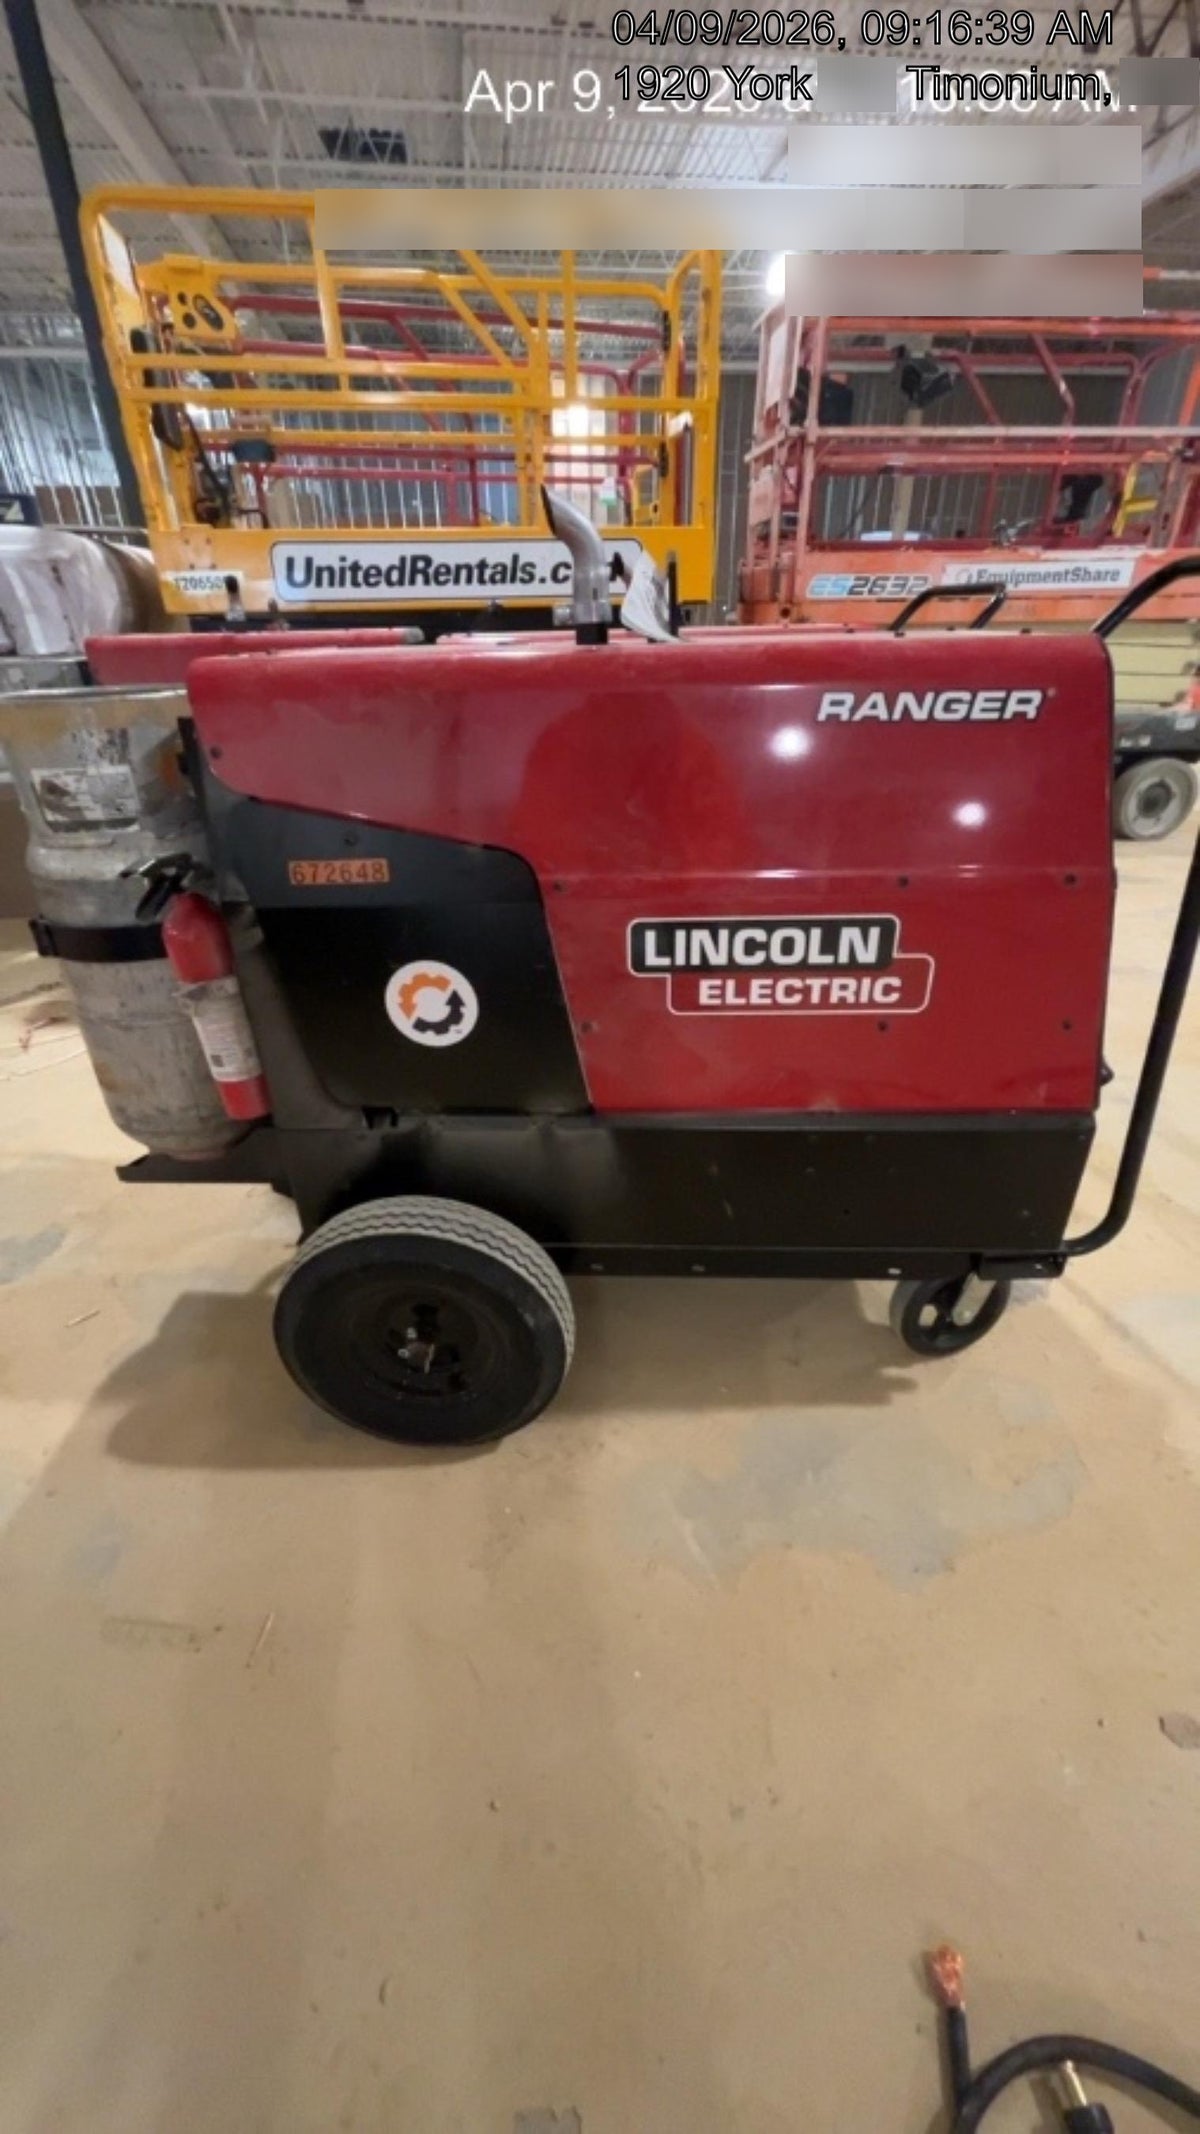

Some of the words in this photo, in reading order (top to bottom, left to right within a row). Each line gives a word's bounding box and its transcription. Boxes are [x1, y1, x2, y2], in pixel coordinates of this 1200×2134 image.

[816, 690, 1043, 722] RANGER
[292, 861, 386, 884] 672648
[644, 926, 881, 967] LINCOLN
[698, 976, 902, 1006] ELECTRIC
